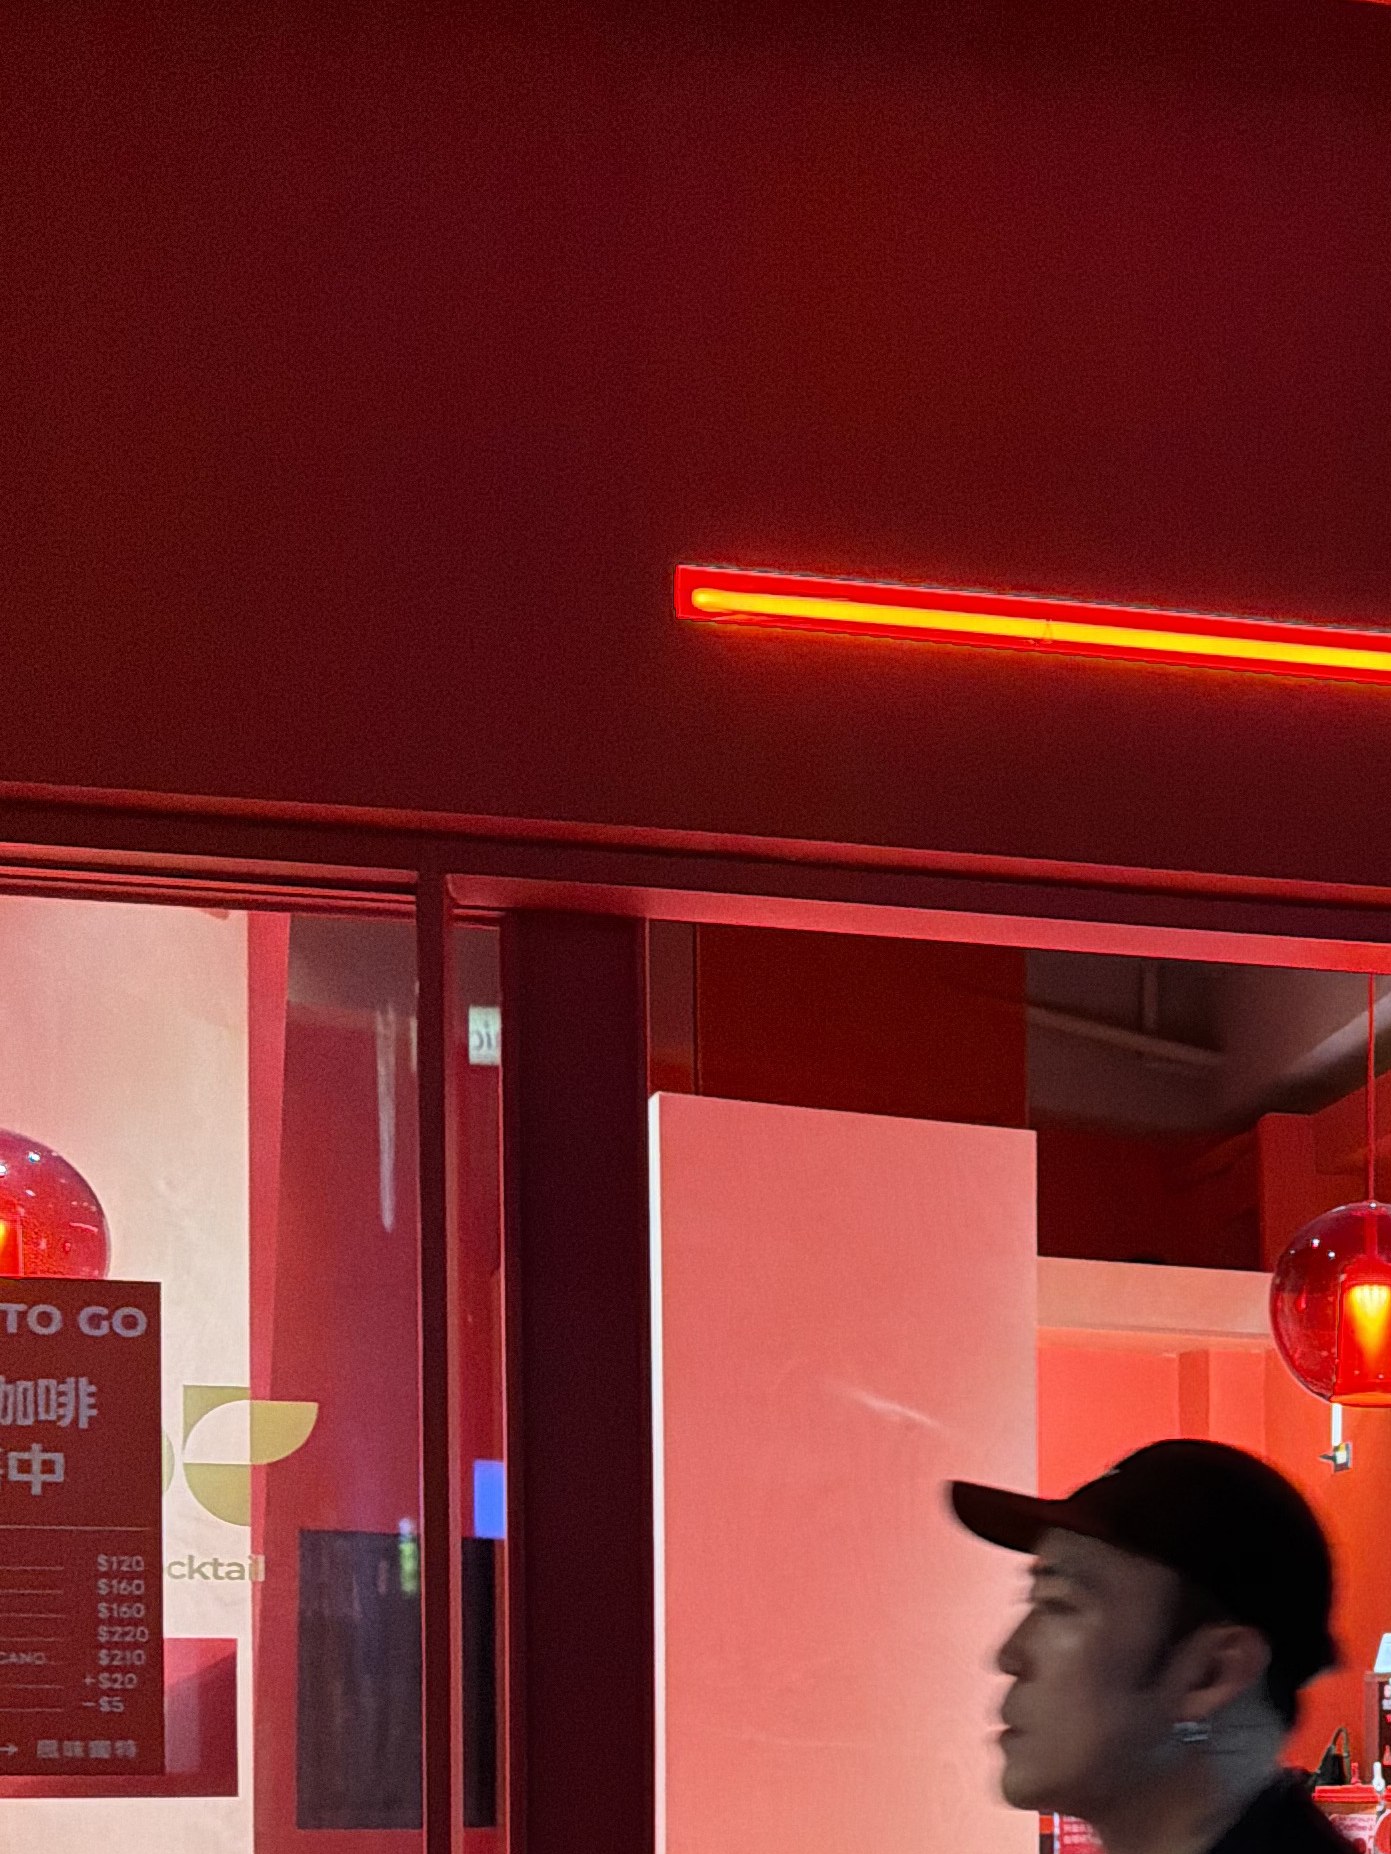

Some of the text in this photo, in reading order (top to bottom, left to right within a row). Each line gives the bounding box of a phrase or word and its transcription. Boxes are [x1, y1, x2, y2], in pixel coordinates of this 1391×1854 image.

[0, 1303, 147, 1337] TO GO
[0, 1443, 65, 1496] 中
[97, 1554, 145, 1571] $120
[97, 1578, 145, 1595] $160
[97, 1602, 145, 1618] $160
[97, 1626, 149, 1642] $220
[98, 1649, 146, 1666] $210
[83, 1673, 137, 1689] +$20
